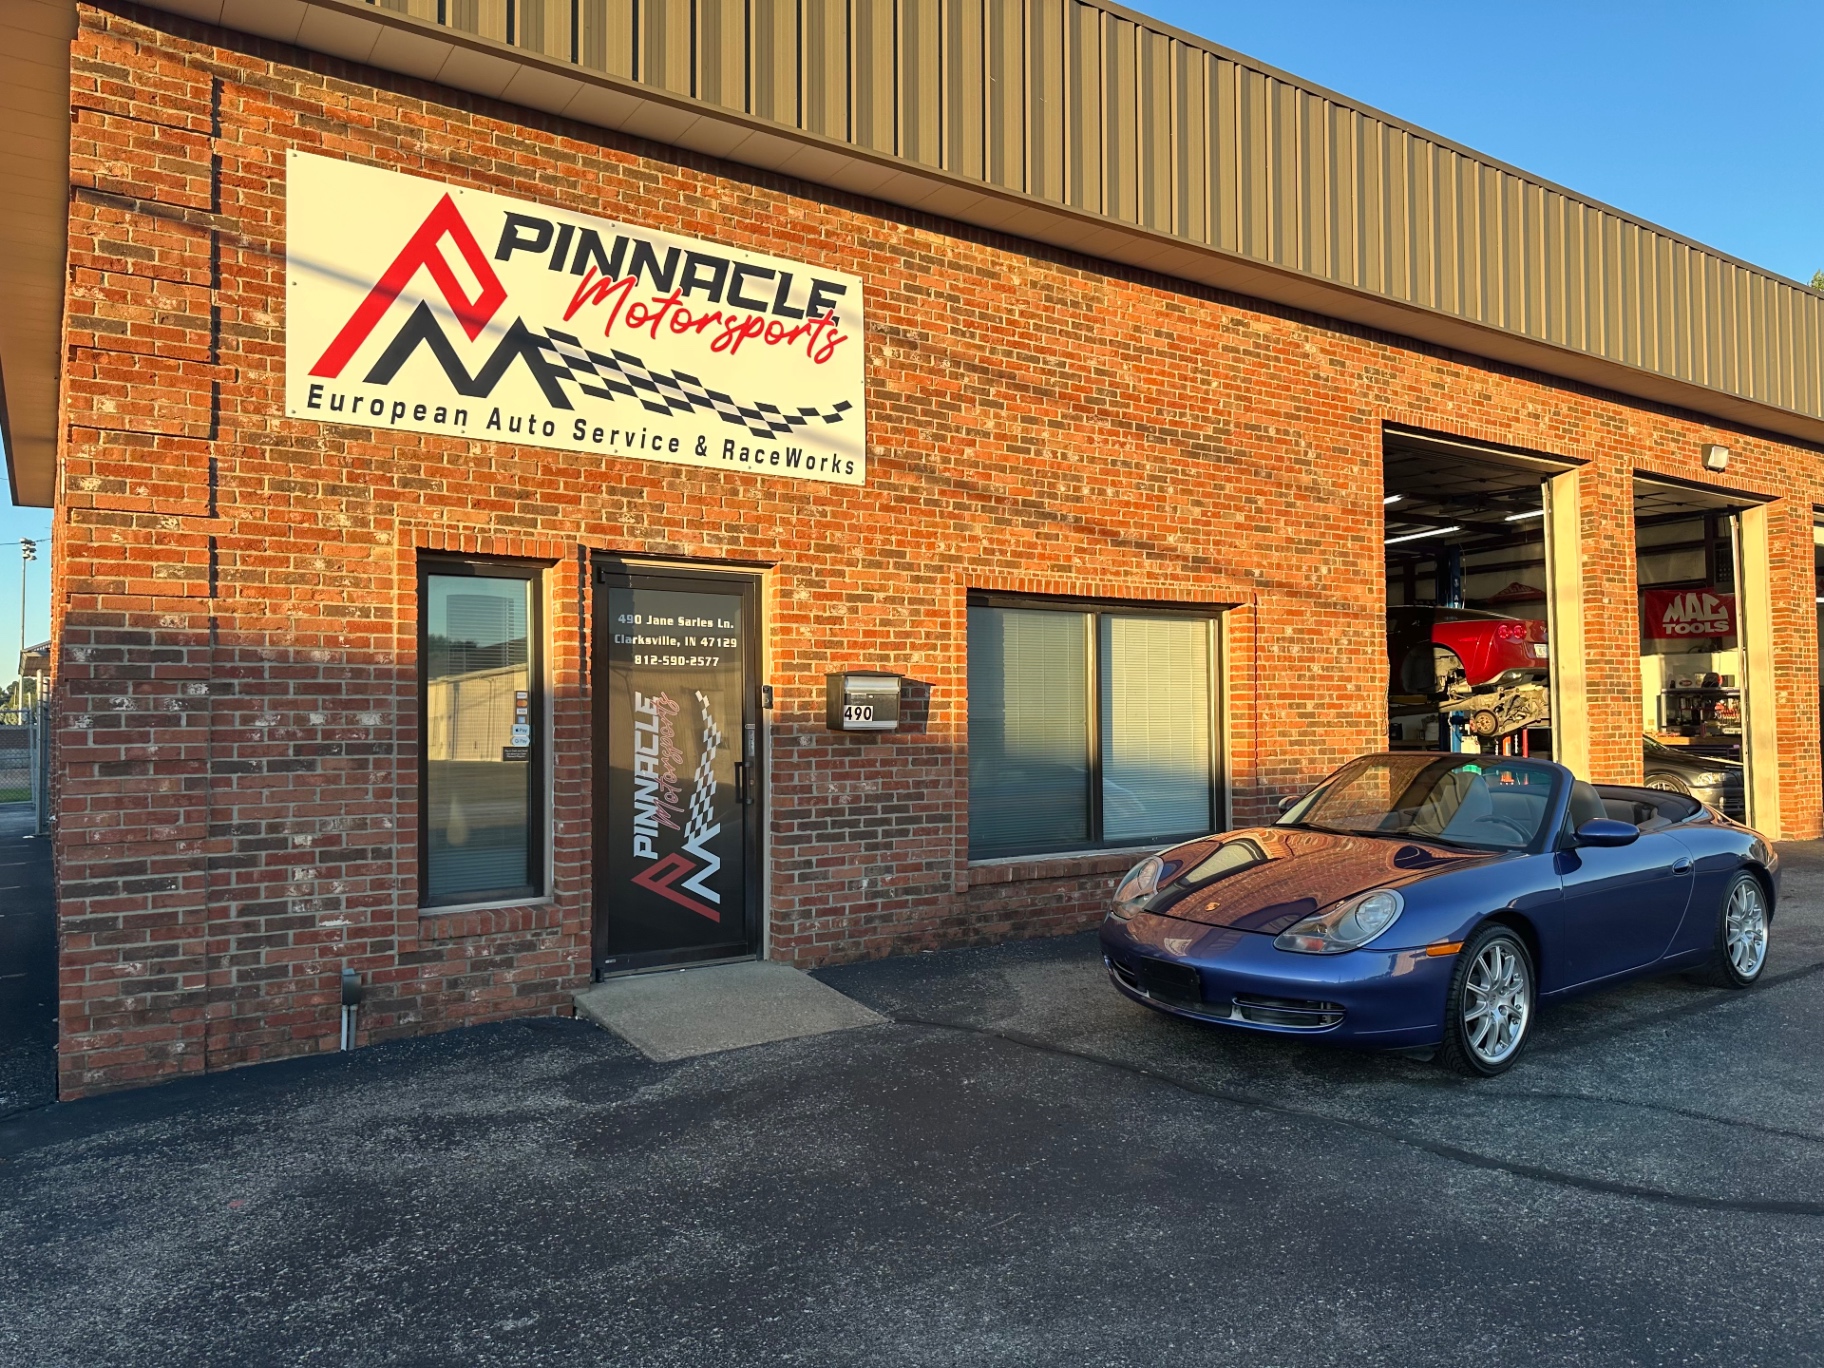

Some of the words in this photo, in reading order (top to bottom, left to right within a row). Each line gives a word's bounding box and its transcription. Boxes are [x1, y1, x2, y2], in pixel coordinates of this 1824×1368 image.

[495, 211, 848, 327] PINNACLE
[562, 264, 848, 364] Motorsports
[307, 383, 468, 426] European
[486, 407, 555, 437] Auto
[573, 418, 680, 453] Service
[694, 435, 707, 457] &
[723, 439, 854, 475] RaceWorks
[618, 614, 642, 625] 490
[646, 615, 674, 626] Jane
[677, 616, 713, 628] Sarles
[717, 618, 734, 629] Ln.
[1662, 592, 1729, 623] MAC
[614, 634, 681, 648] Clarksville,
[684, 636, 696, 647] IN
[700, 637, 737, 648] 47129
[1662, 620, 1730, 635] TOOLS
[634, 655, 719, 666] 812-590-2577
[844, 706, 872, 721] 490
[633, 691, 660, 860] PINNACLE
[650, 691, 684, 831] Motorsports
